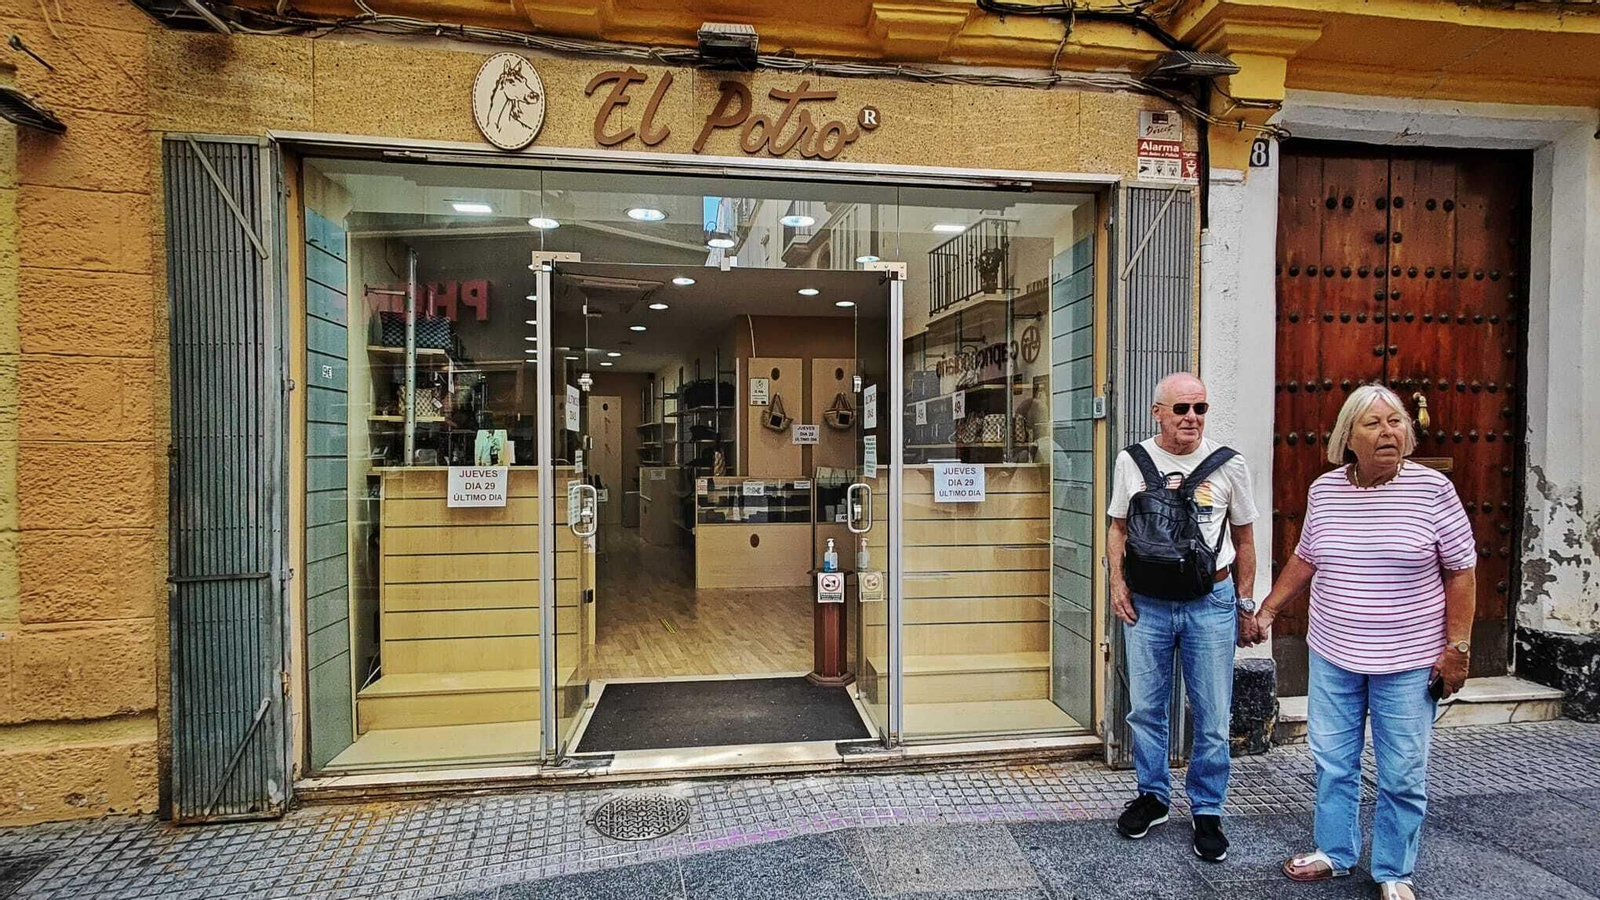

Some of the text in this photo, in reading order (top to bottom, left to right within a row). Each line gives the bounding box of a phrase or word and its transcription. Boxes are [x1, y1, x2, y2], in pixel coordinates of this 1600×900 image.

[585, 66, 860, 160] El Potro
[1140, 141, 1180, 152] Alarma
[1253, 142, 1266, 166] 8
[459, 470, 498, 478] JUEVES
[943, 467, 976, 475] JUEVES
[465, 482, 496, 490] DIA 29
[948, 479, 974, 487] DIA 29
[453, 493, 487, 501] ÚLTIMO
[939, 489, 967, 497] ÚLTIMO
